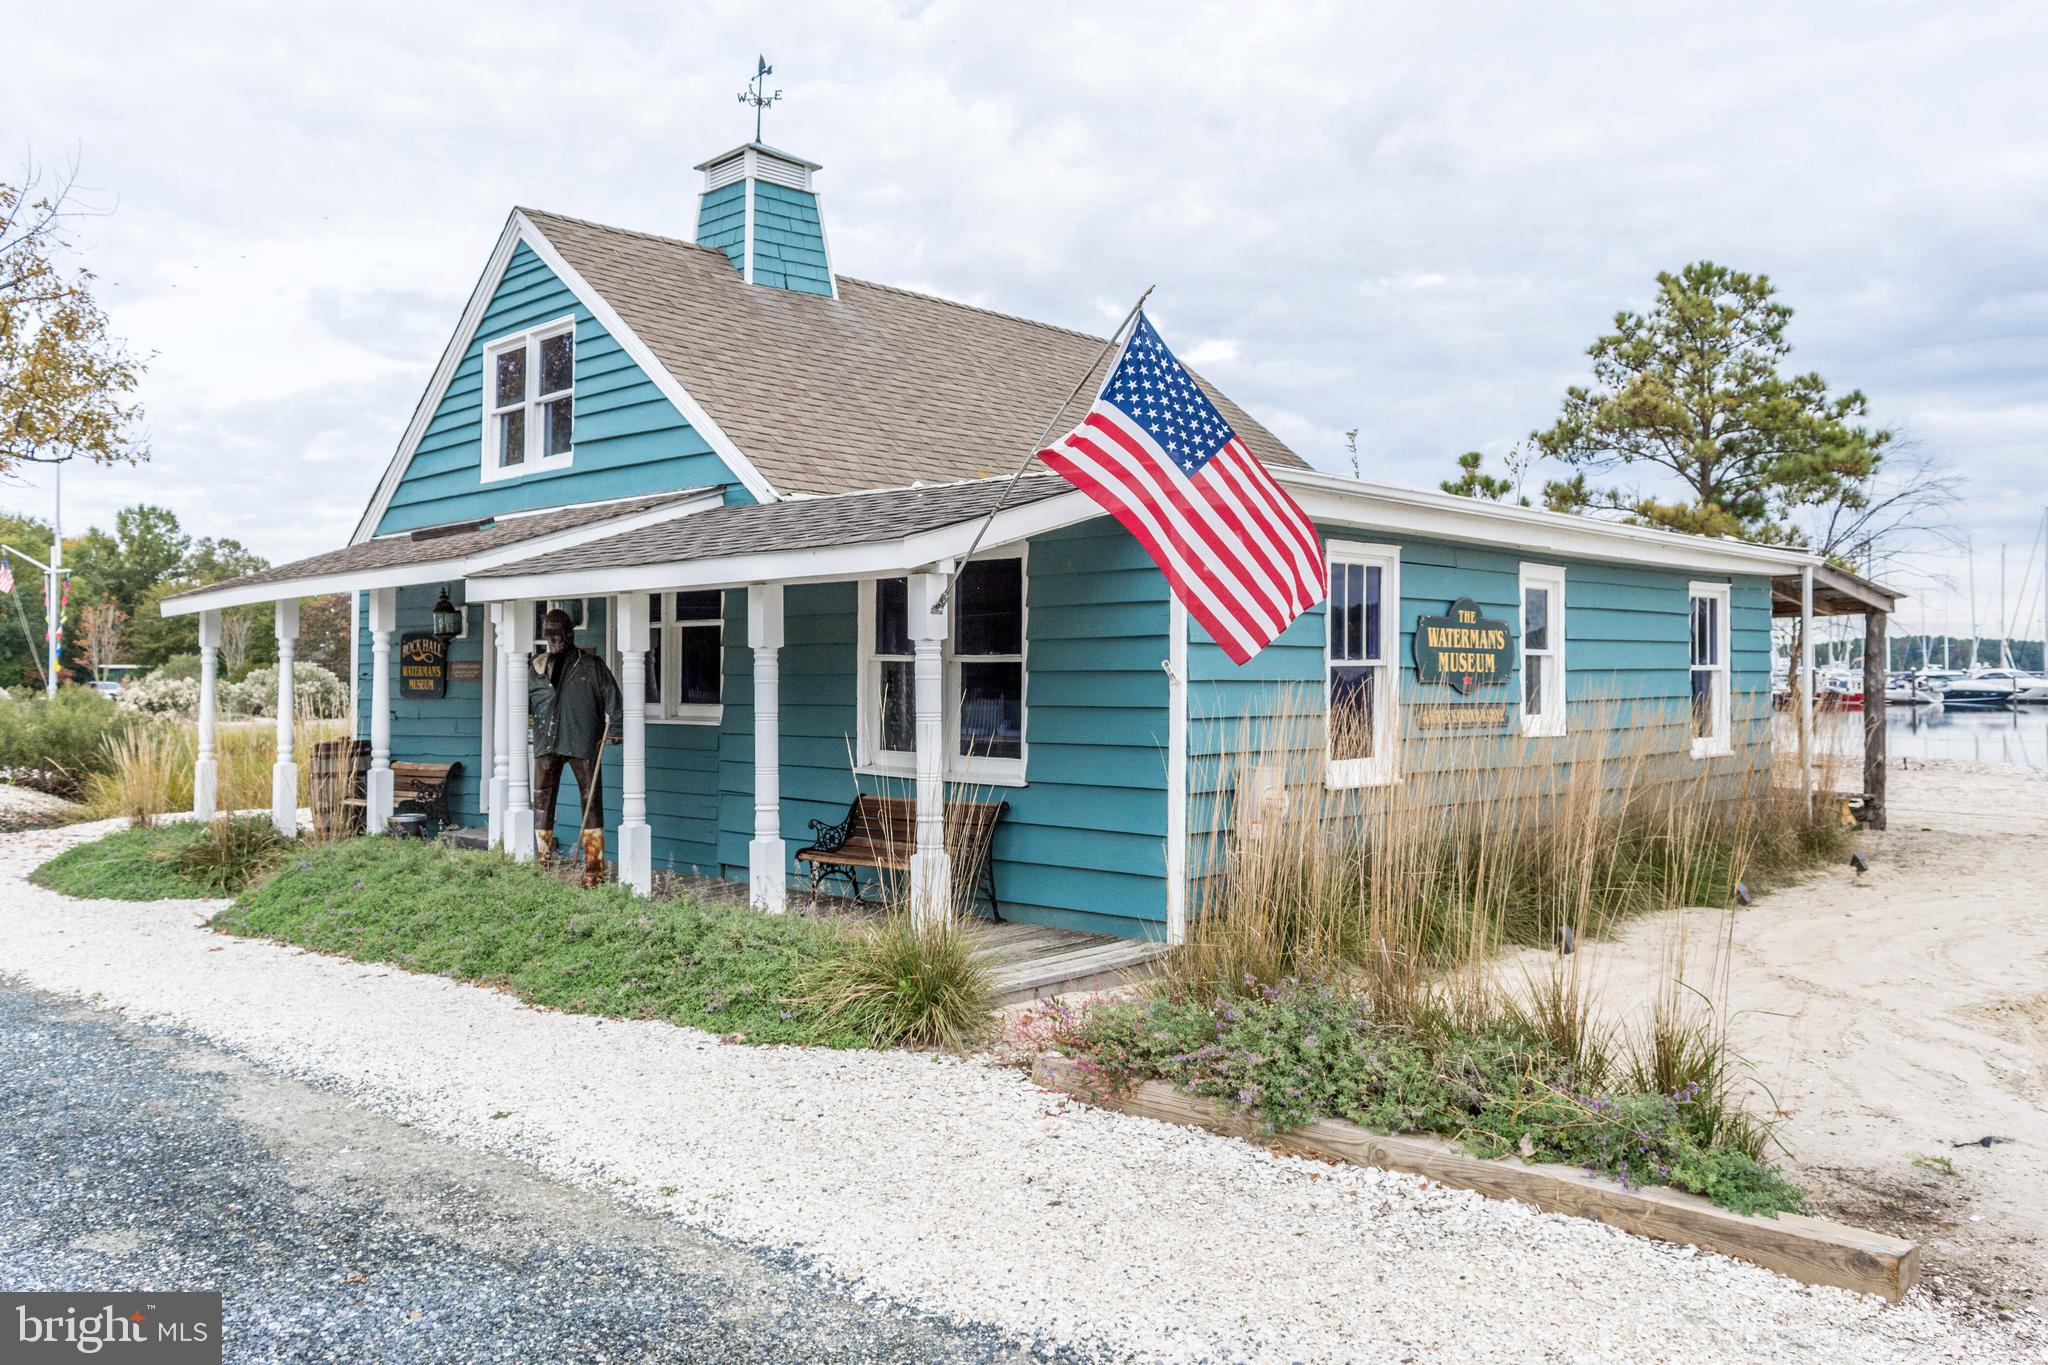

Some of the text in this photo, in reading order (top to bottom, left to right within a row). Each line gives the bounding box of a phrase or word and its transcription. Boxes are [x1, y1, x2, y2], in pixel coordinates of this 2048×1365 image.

[737, 92, 747, 103] W
[774, 89, 782, 100] E
[1458, 609, 1477, 624] THE
[402, 639, 442, 659] ROCK HALL
[1438, 652, 1495, 673] MUSEUM
[408, 679, 434, 690] MUSEUM
